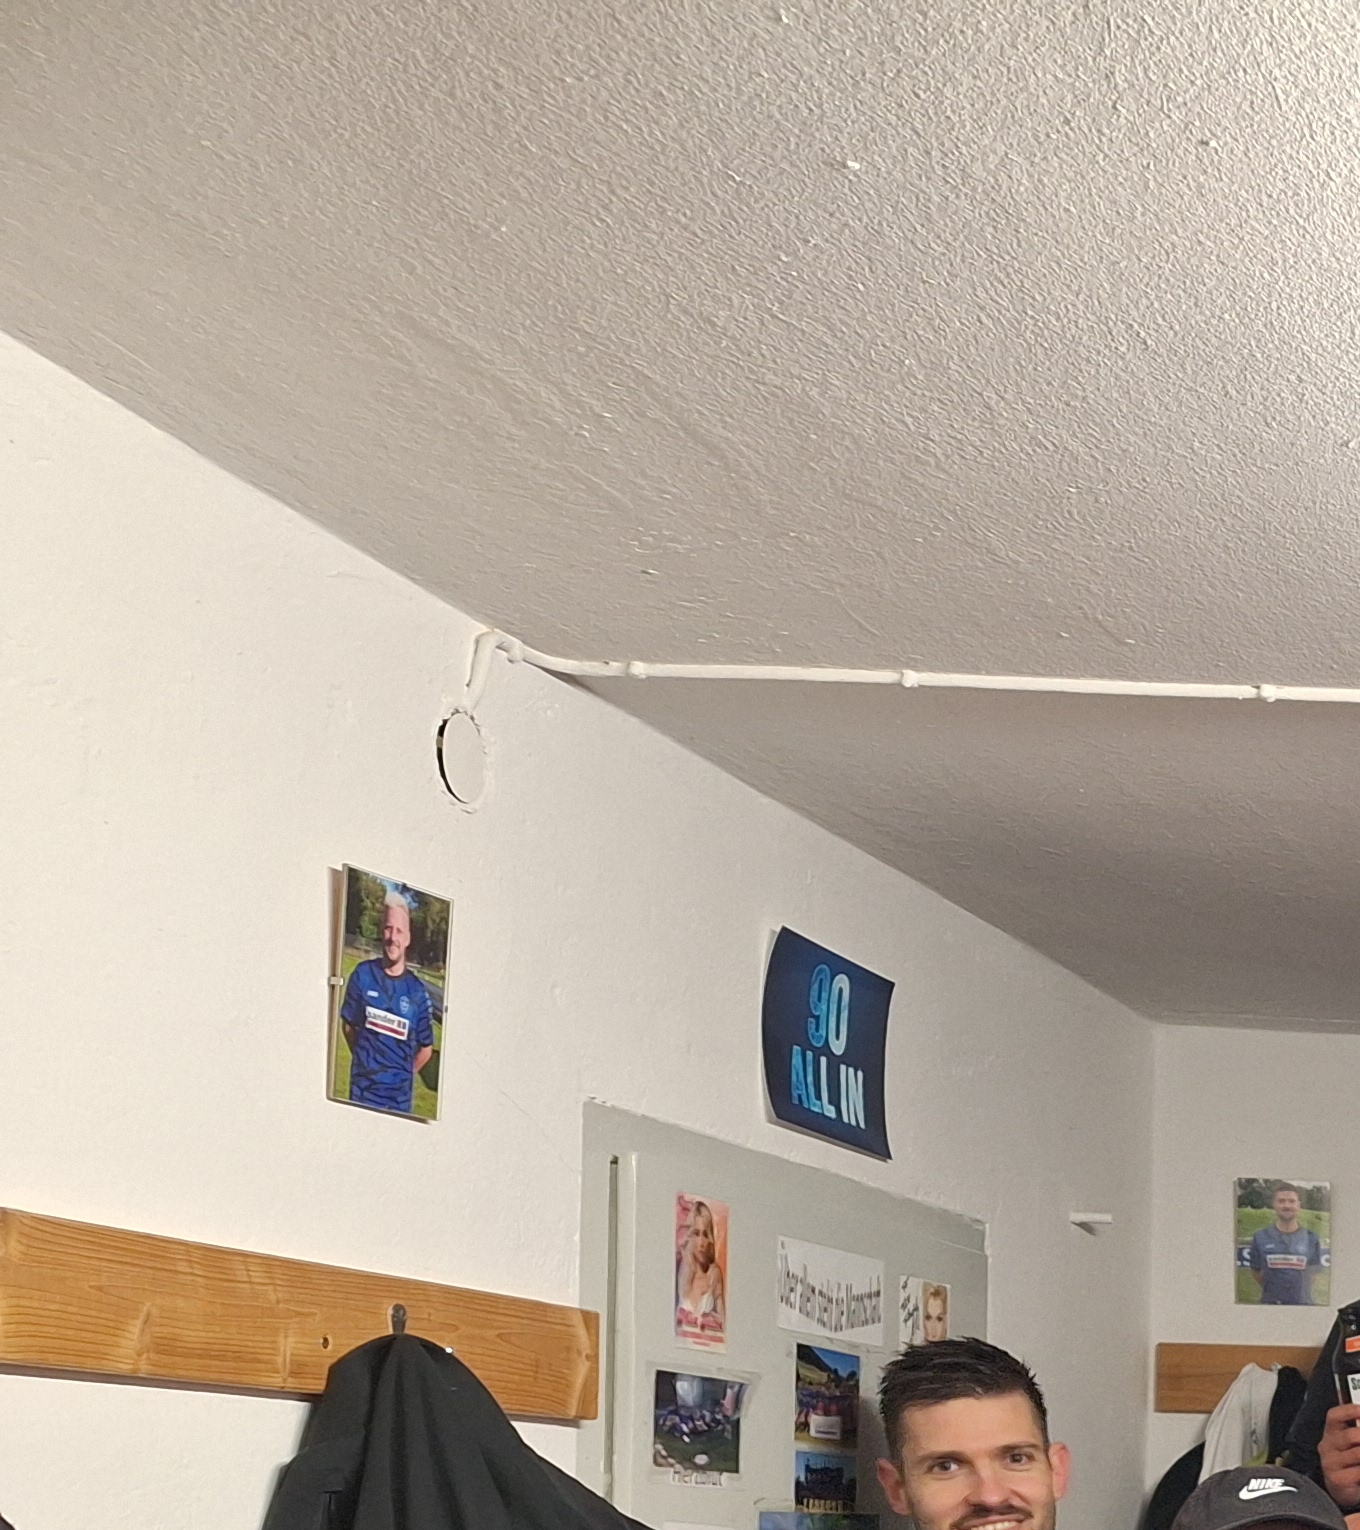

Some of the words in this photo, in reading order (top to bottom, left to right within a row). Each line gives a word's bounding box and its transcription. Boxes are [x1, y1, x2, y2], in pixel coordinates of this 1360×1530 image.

[807, 964, 850, 1056] 90
[791, 1045, 836, 1119] ALL
[840, 1064, 866, 1130] IN
[1248, 1478, 1285, 1490] NIKE
